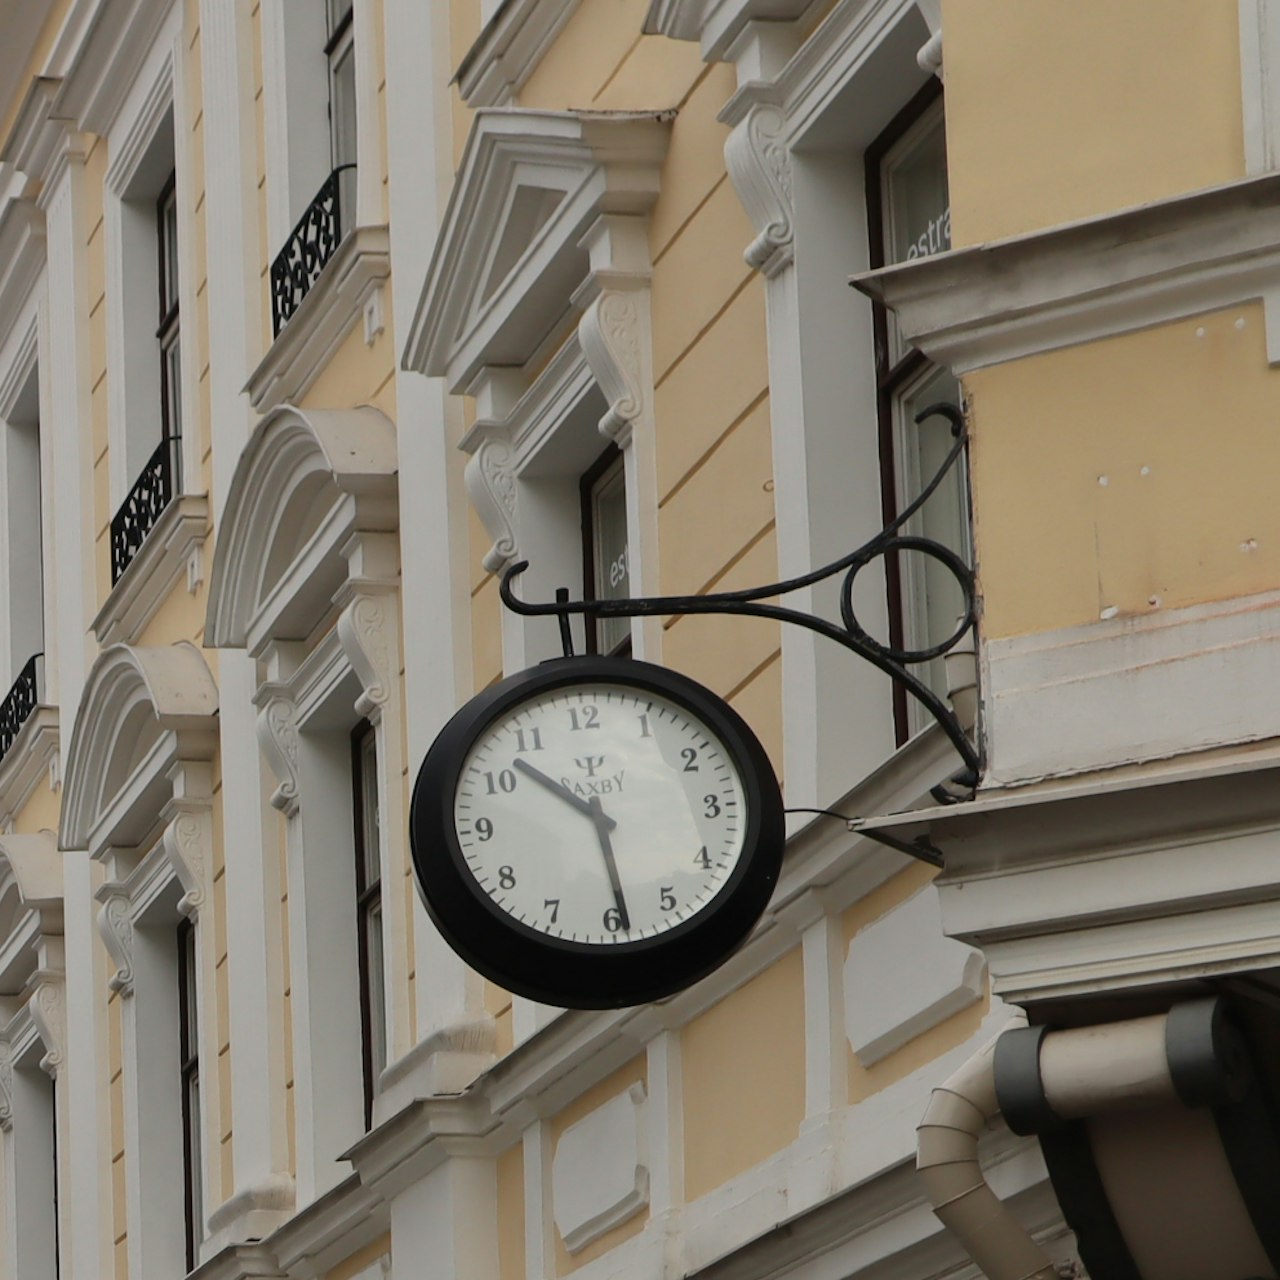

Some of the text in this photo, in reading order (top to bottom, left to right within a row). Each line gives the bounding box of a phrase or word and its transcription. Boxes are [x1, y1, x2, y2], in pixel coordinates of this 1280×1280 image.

[567, 705, 601, 732] 12
[637, 714, 653, 738] 1
[514, 727, 544, 752] 11
[680, 748, 699, 772] 2
[483, 769, 517, 795] 10
[560, 770, 626, 797] SAXBY
[703, 794, 721, 819] 3
[475, 817, 494, 842] 9
[693, 845, 712, 870] 4
[498, 865, 516, 889] 8
[543, 899, 560, 923] 7
[660, 886, 677, 911] 5
[603, 907, 622, 932] 6
